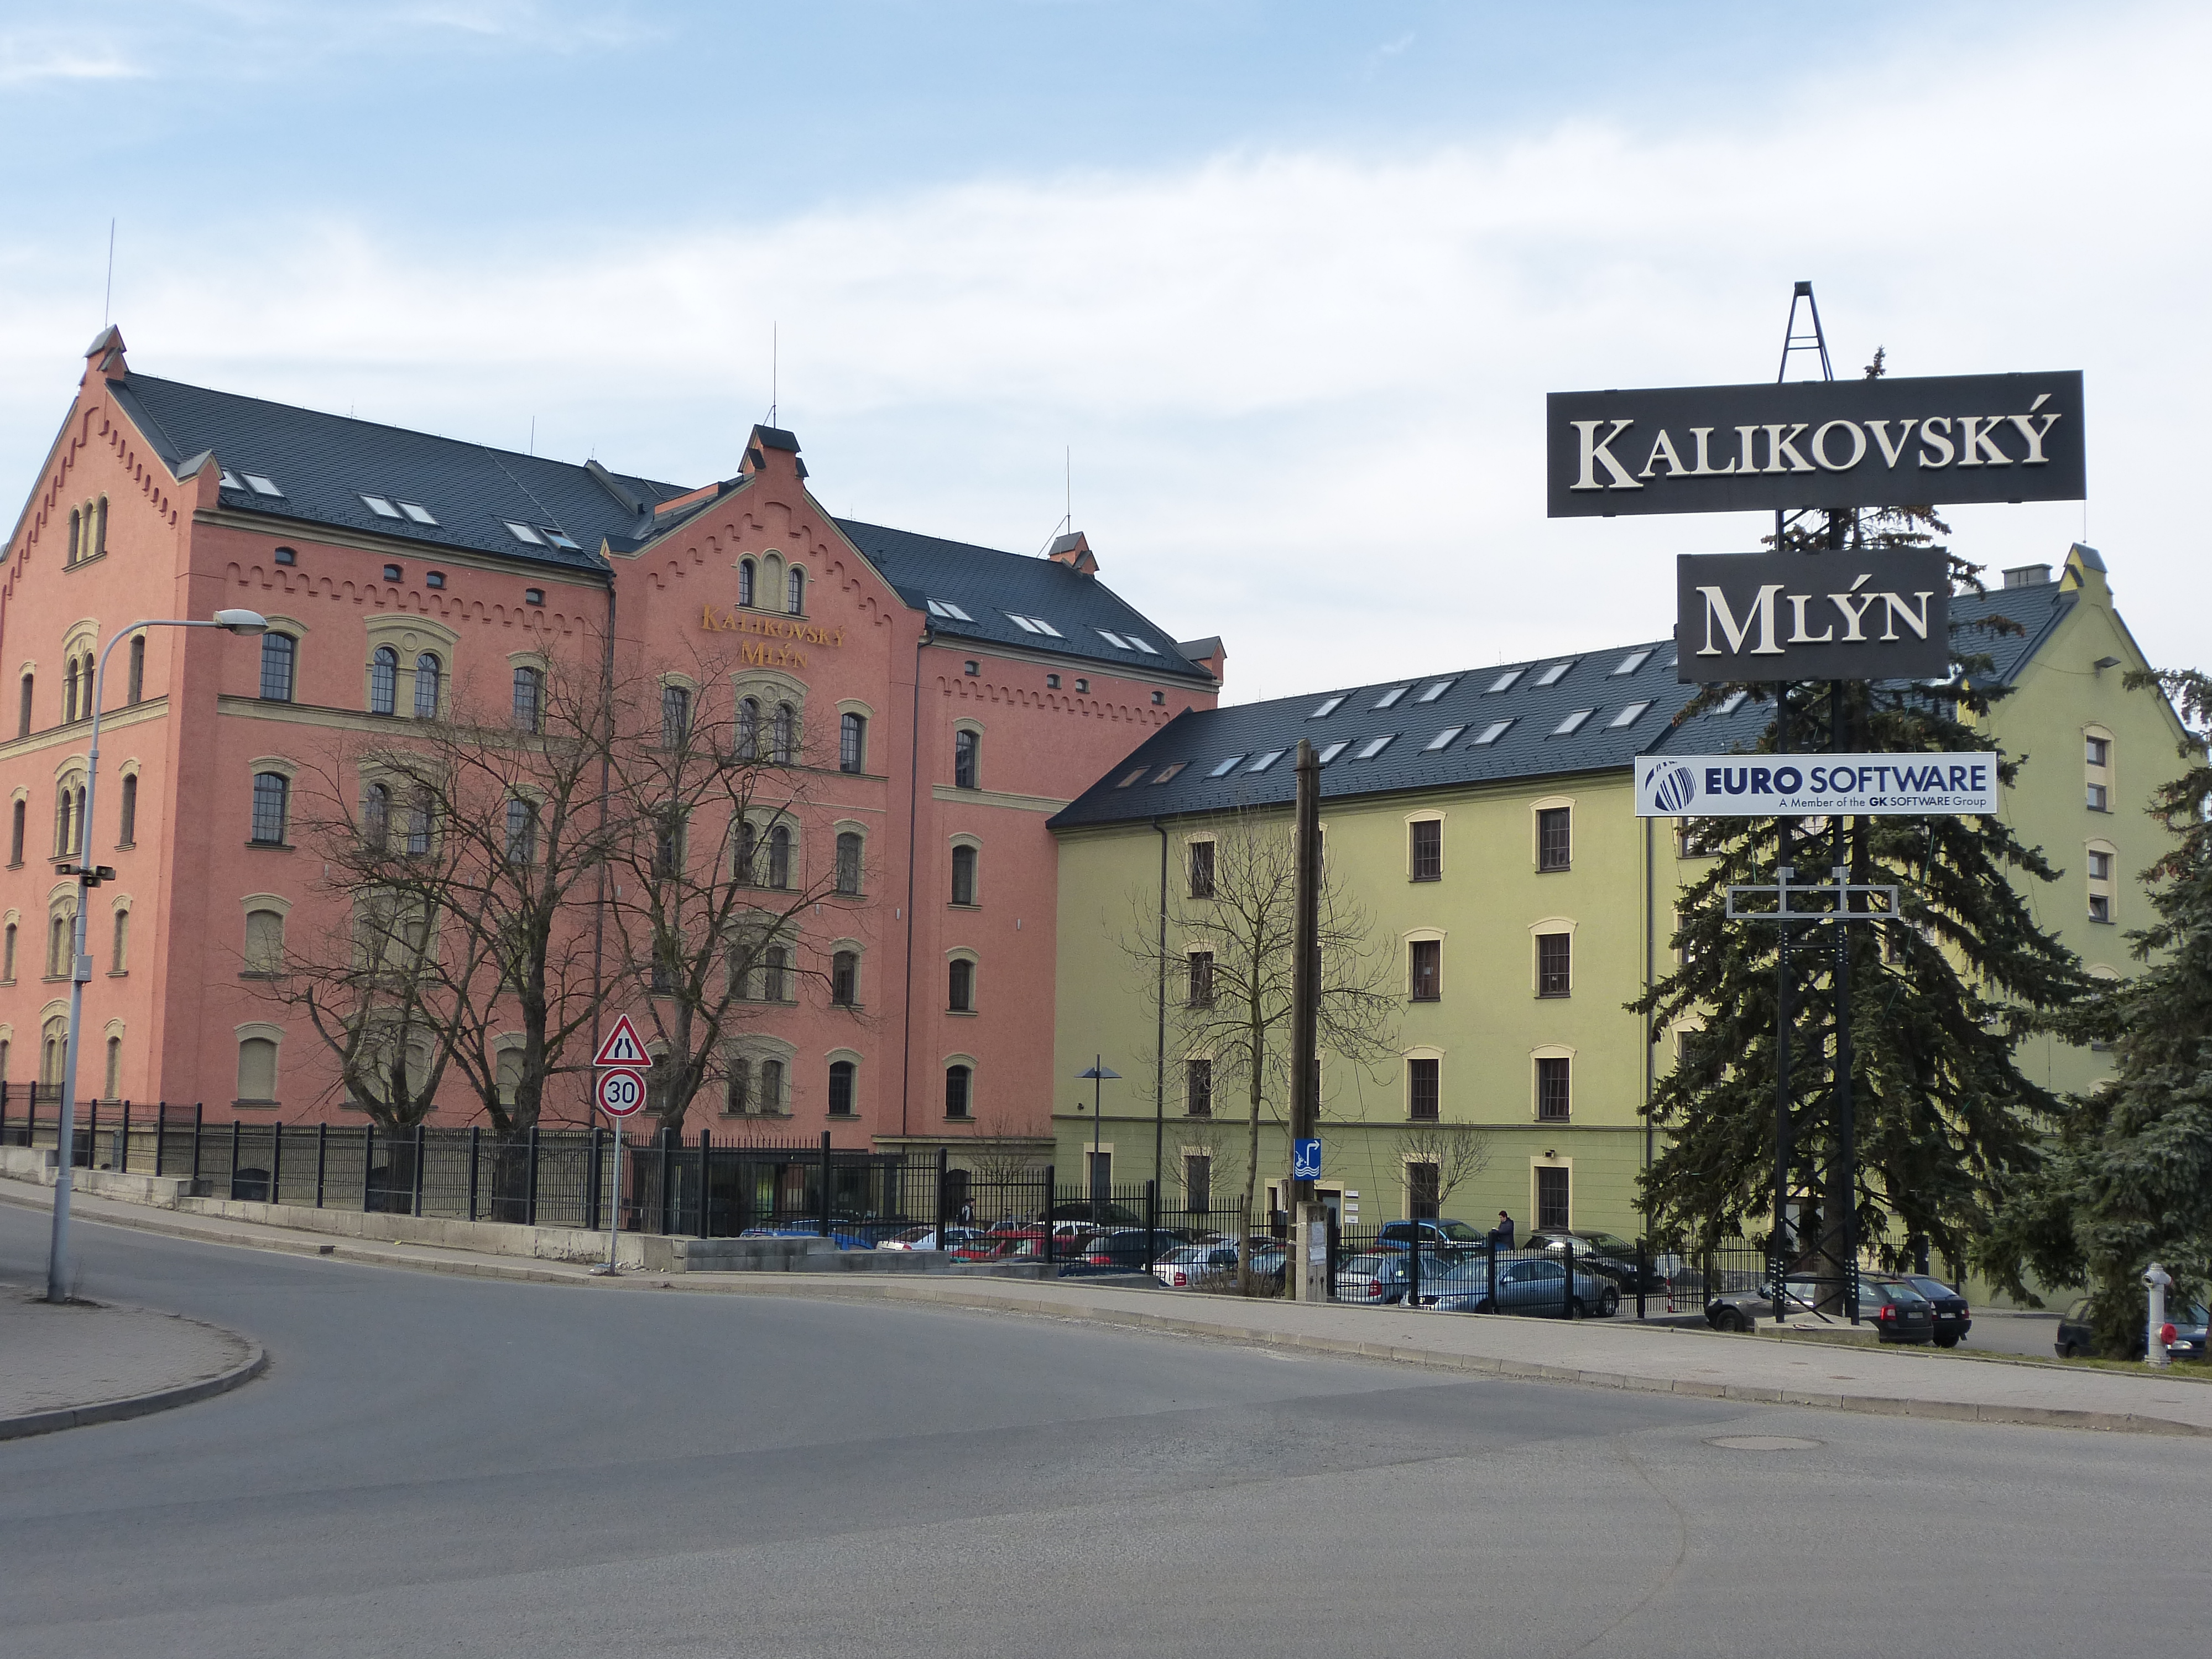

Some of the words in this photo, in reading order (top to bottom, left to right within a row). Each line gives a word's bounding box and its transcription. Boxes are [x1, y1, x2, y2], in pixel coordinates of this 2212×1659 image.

[1569, 393, 2062, 489] KALIKOVSKÝ
[701, 604, 847, 648] KALIKOVSKÝ
[1695, 573, 1934, 655] MLÝN
[740, 639, 809, 669] MLÝN
[1704, 766, 1803, 795] EURO
[1809, 765, 1987, 794] SOFTWARE
[1778, 798, 1788, 807] A
[1791, 796, 1834, 807] Member
[1837, 796, 1848, 807] of
[1849, 796, 1865, 807] the
[1869, 796, 1888, 807] GK
[1890, 796, 1950, 806] SOFTWARE
[1953, 796, 1987, 809] Group
[607, 1081, 635, 1104] 30
